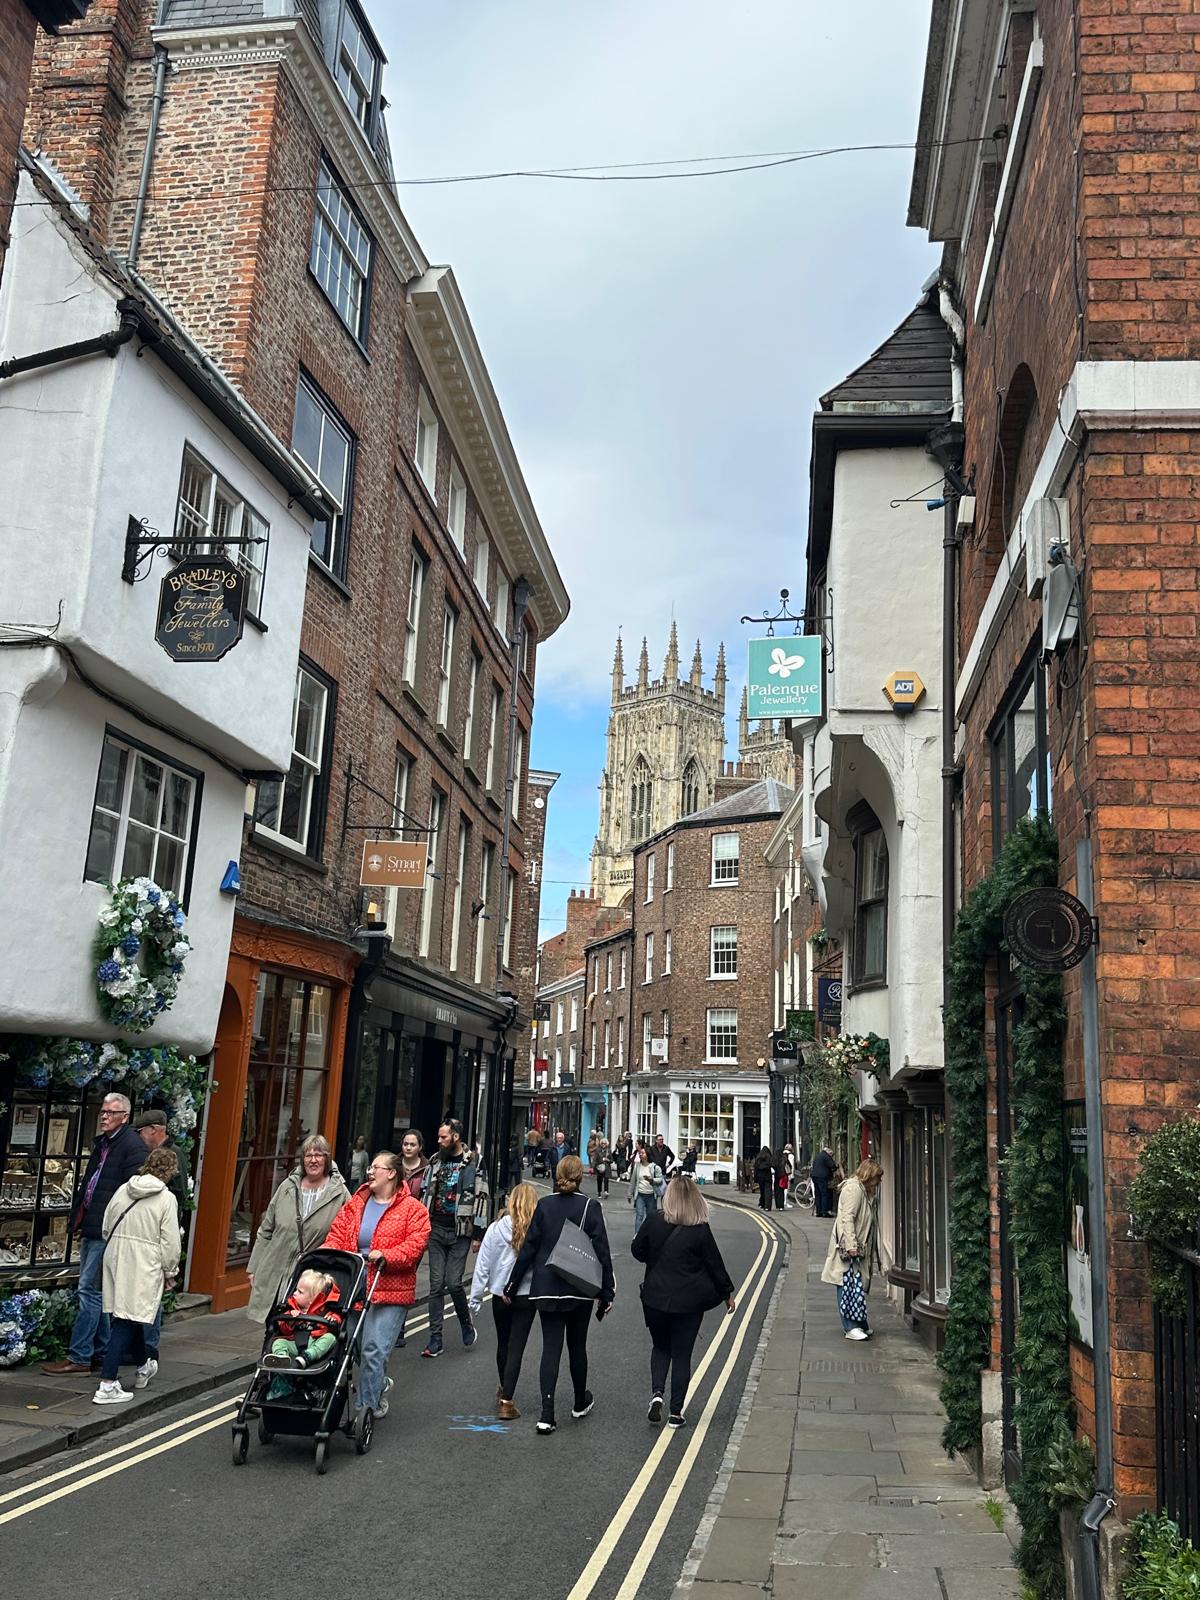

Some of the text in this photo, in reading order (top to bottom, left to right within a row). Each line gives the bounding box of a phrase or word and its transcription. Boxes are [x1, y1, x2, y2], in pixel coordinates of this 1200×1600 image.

[169, 568, 237, 591] BRADLEYS
[174, 595, 225, 617] Family
[164, 613, 230, 633] Jewellers
[176, 643, 215, 653] Since 1970
[750, 684, 819, 697] Palenque
[895, 682, 914, 691] ADT
[760, 696, 808, 705] Jewellery
[387, 856, 421, 869] Smart
[685, 1081, 721, 1090] AZENDI
